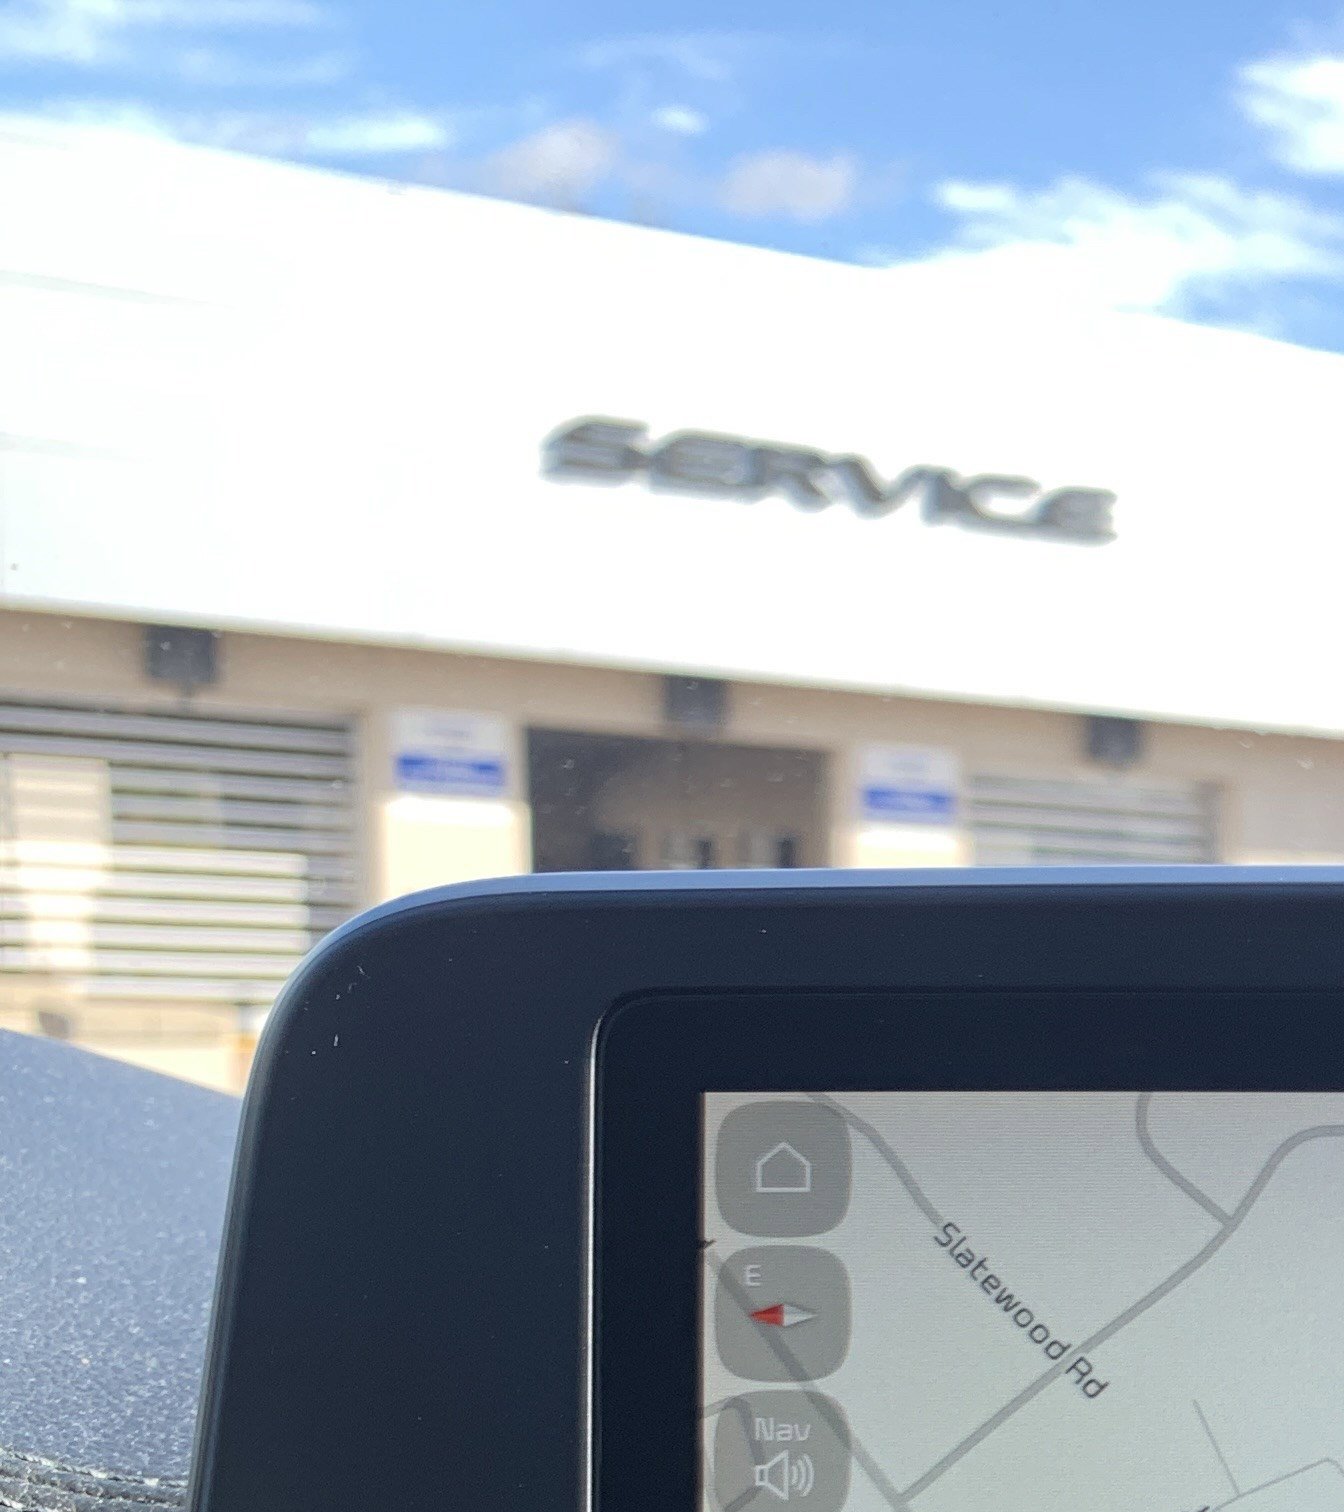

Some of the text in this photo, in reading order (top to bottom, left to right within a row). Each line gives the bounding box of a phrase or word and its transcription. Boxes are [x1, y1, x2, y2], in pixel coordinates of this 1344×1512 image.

[539, 414, 1118, 547] SERVICE
[743, 1263, 763, 1288] E
[933, 1221, 1111, 1400] Slatewood Rd
[754, 1417, 812, 1442] Nav
